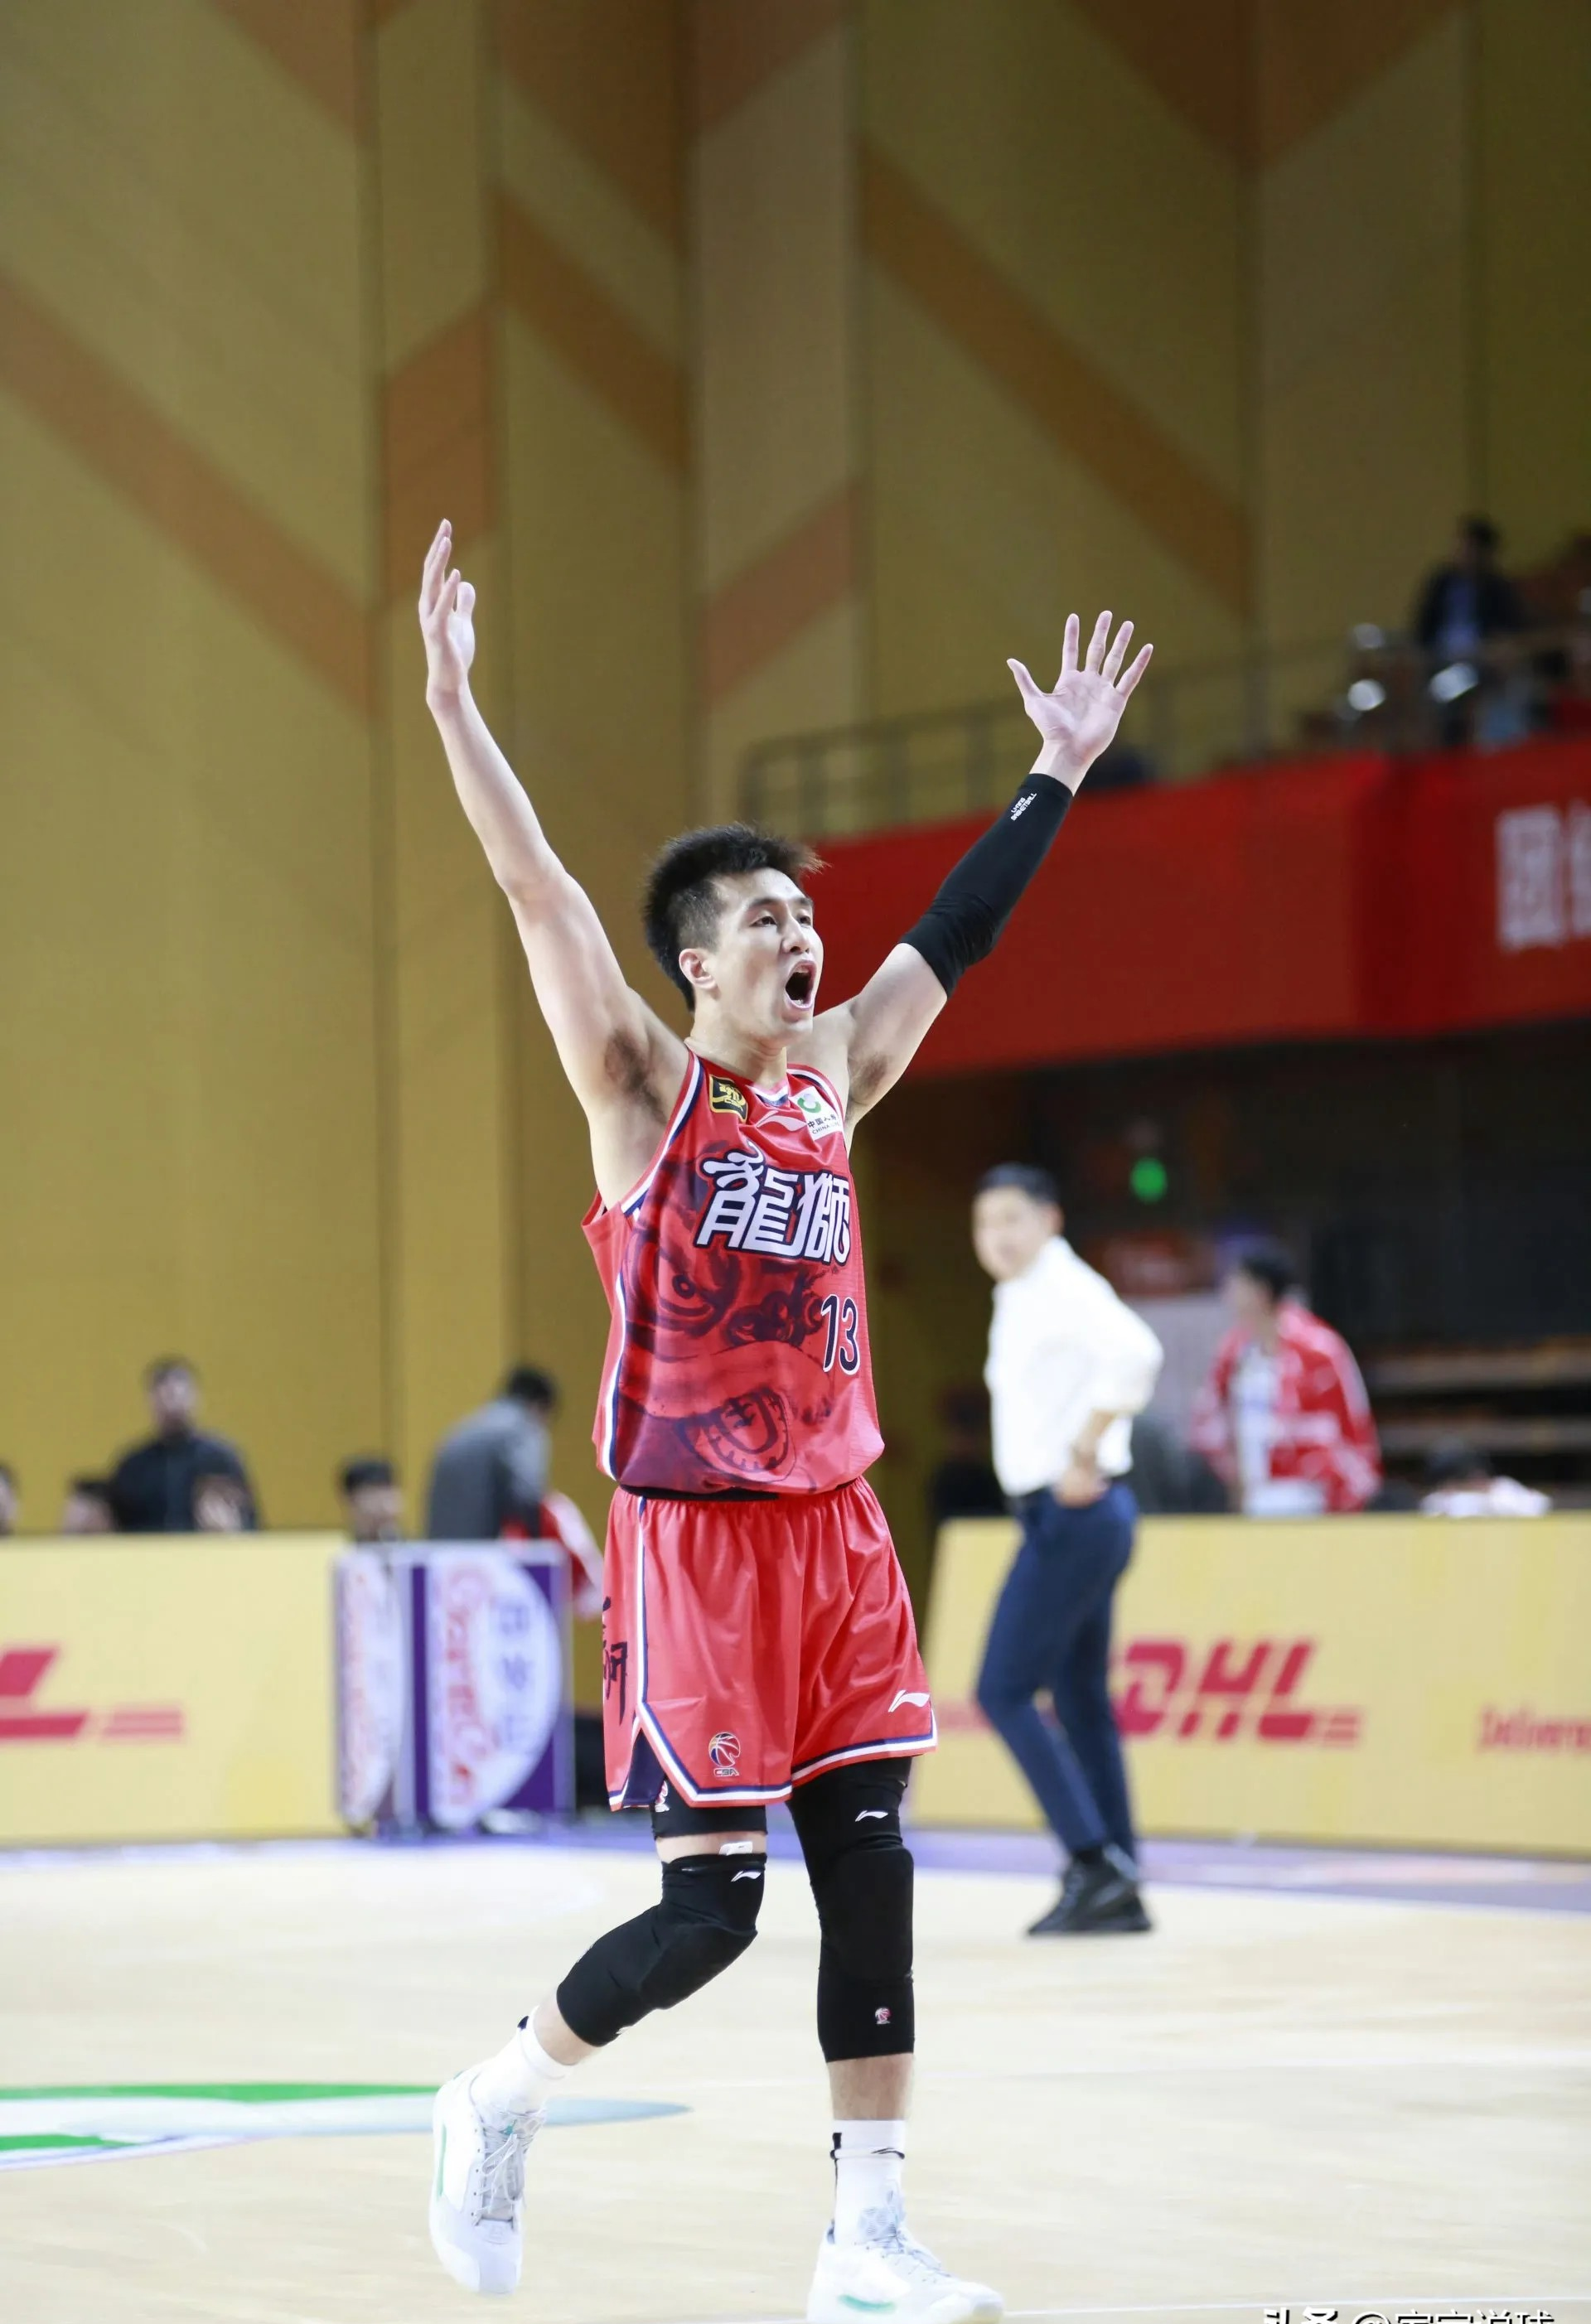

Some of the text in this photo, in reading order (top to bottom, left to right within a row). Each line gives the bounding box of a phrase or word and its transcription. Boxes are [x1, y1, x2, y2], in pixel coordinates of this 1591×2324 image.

[812, 1124, 829, 1134] CHINA
[820, 1294, 860, 1375] 13
[1110, 1640, 1314, 1738] DHL
[713, 1767, 740, 1776] CBA
